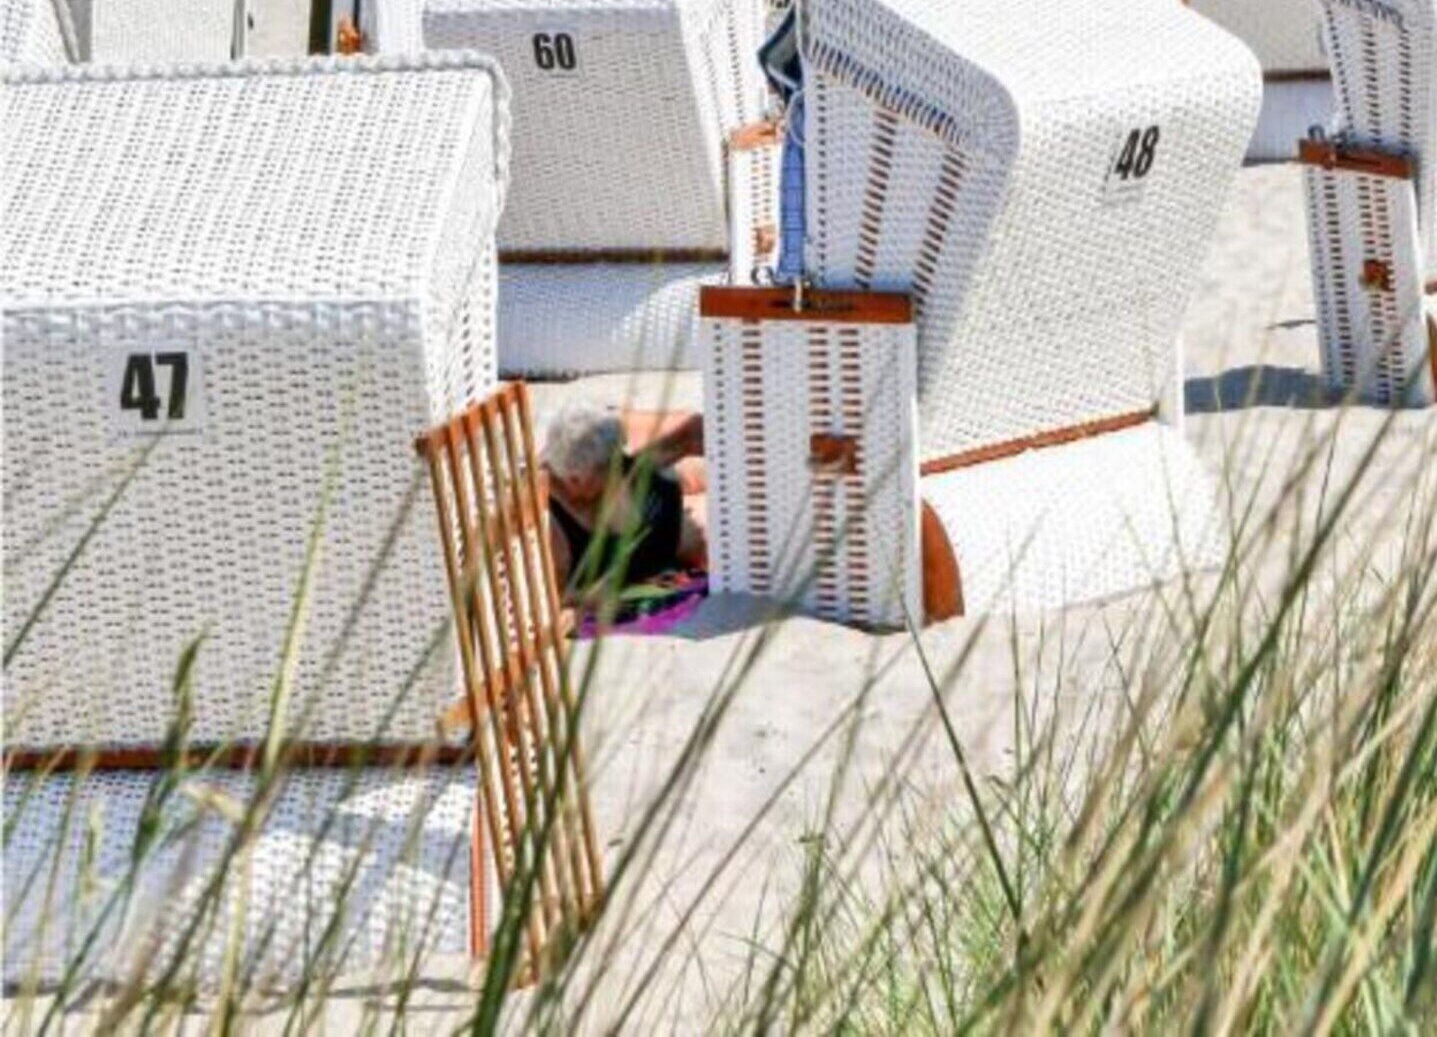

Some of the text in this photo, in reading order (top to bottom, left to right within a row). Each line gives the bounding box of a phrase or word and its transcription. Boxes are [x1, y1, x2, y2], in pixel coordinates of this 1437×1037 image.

[531, 32, 578, 71] 60
[1115, 124, 1161, 180] 48
[120, 351, 189, 420] 47
